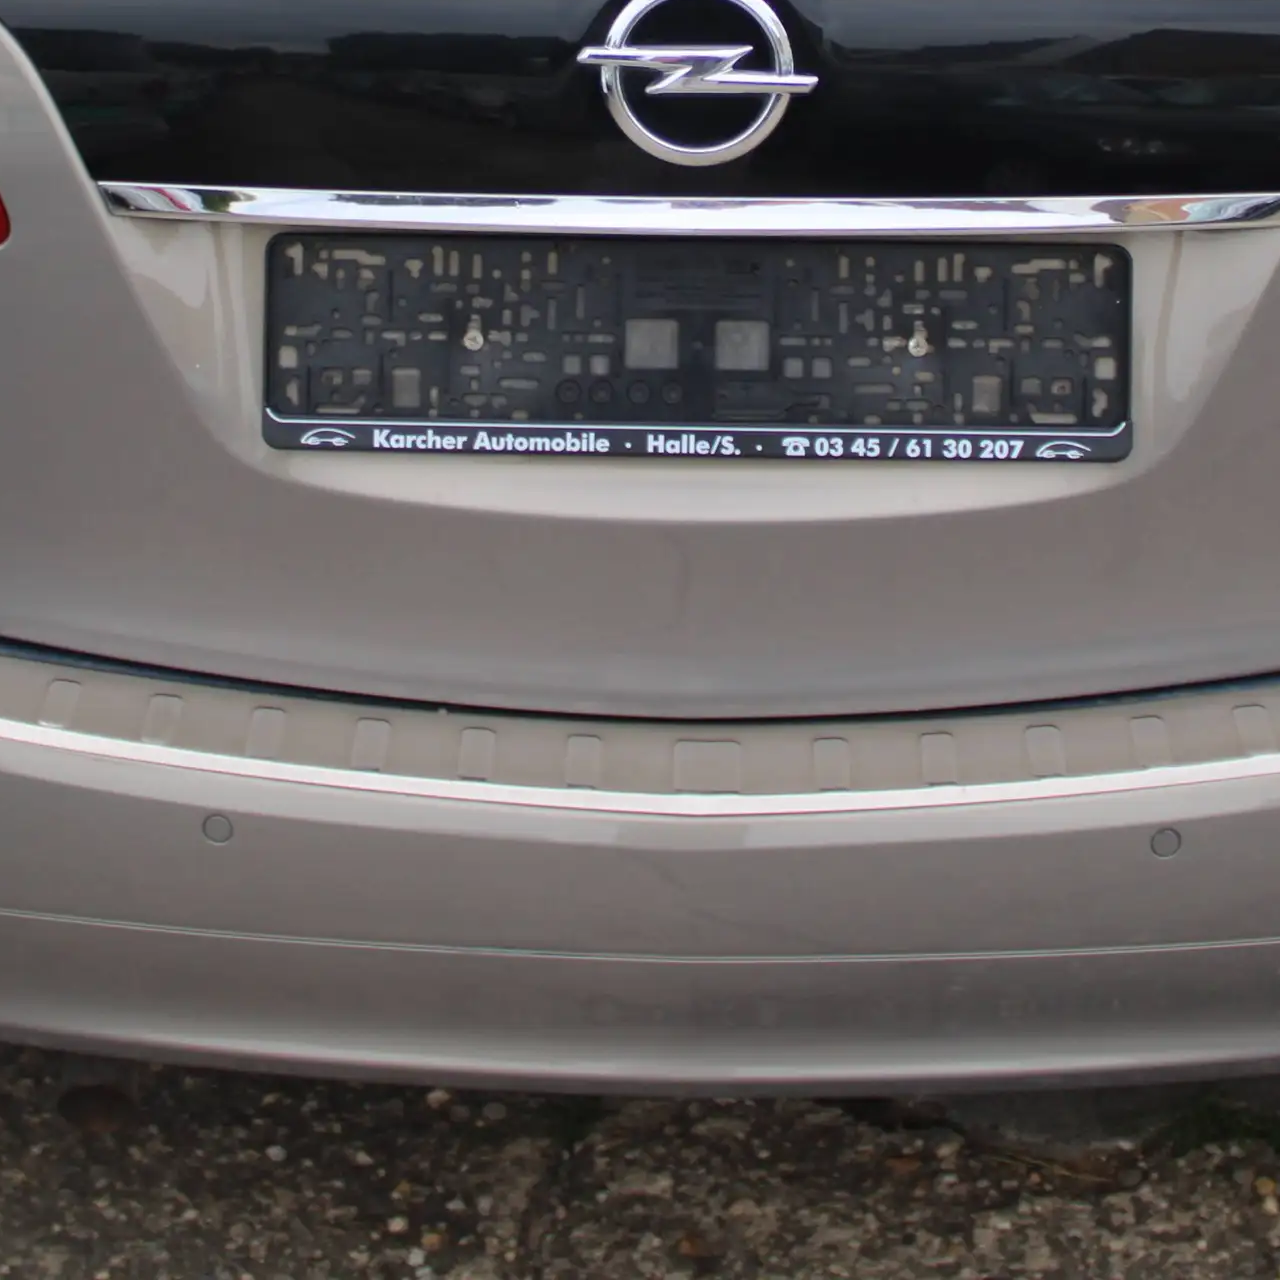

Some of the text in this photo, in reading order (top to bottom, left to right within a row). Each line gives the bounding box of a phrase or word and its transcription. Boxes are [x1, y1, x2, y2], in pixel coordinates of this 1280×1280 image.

[372, 428, 468, 450] Karcher
[473, 431, 610, 453] Automobile
[646, 434, 742, 456] Halle/S.
[814, 437, 844, 457] 03
[850, 438, 881, 458] 45
[905, 438, 933, 458] 61
[942, 438, 973, 459] 30
[979, 440, 1024, 460] 207
